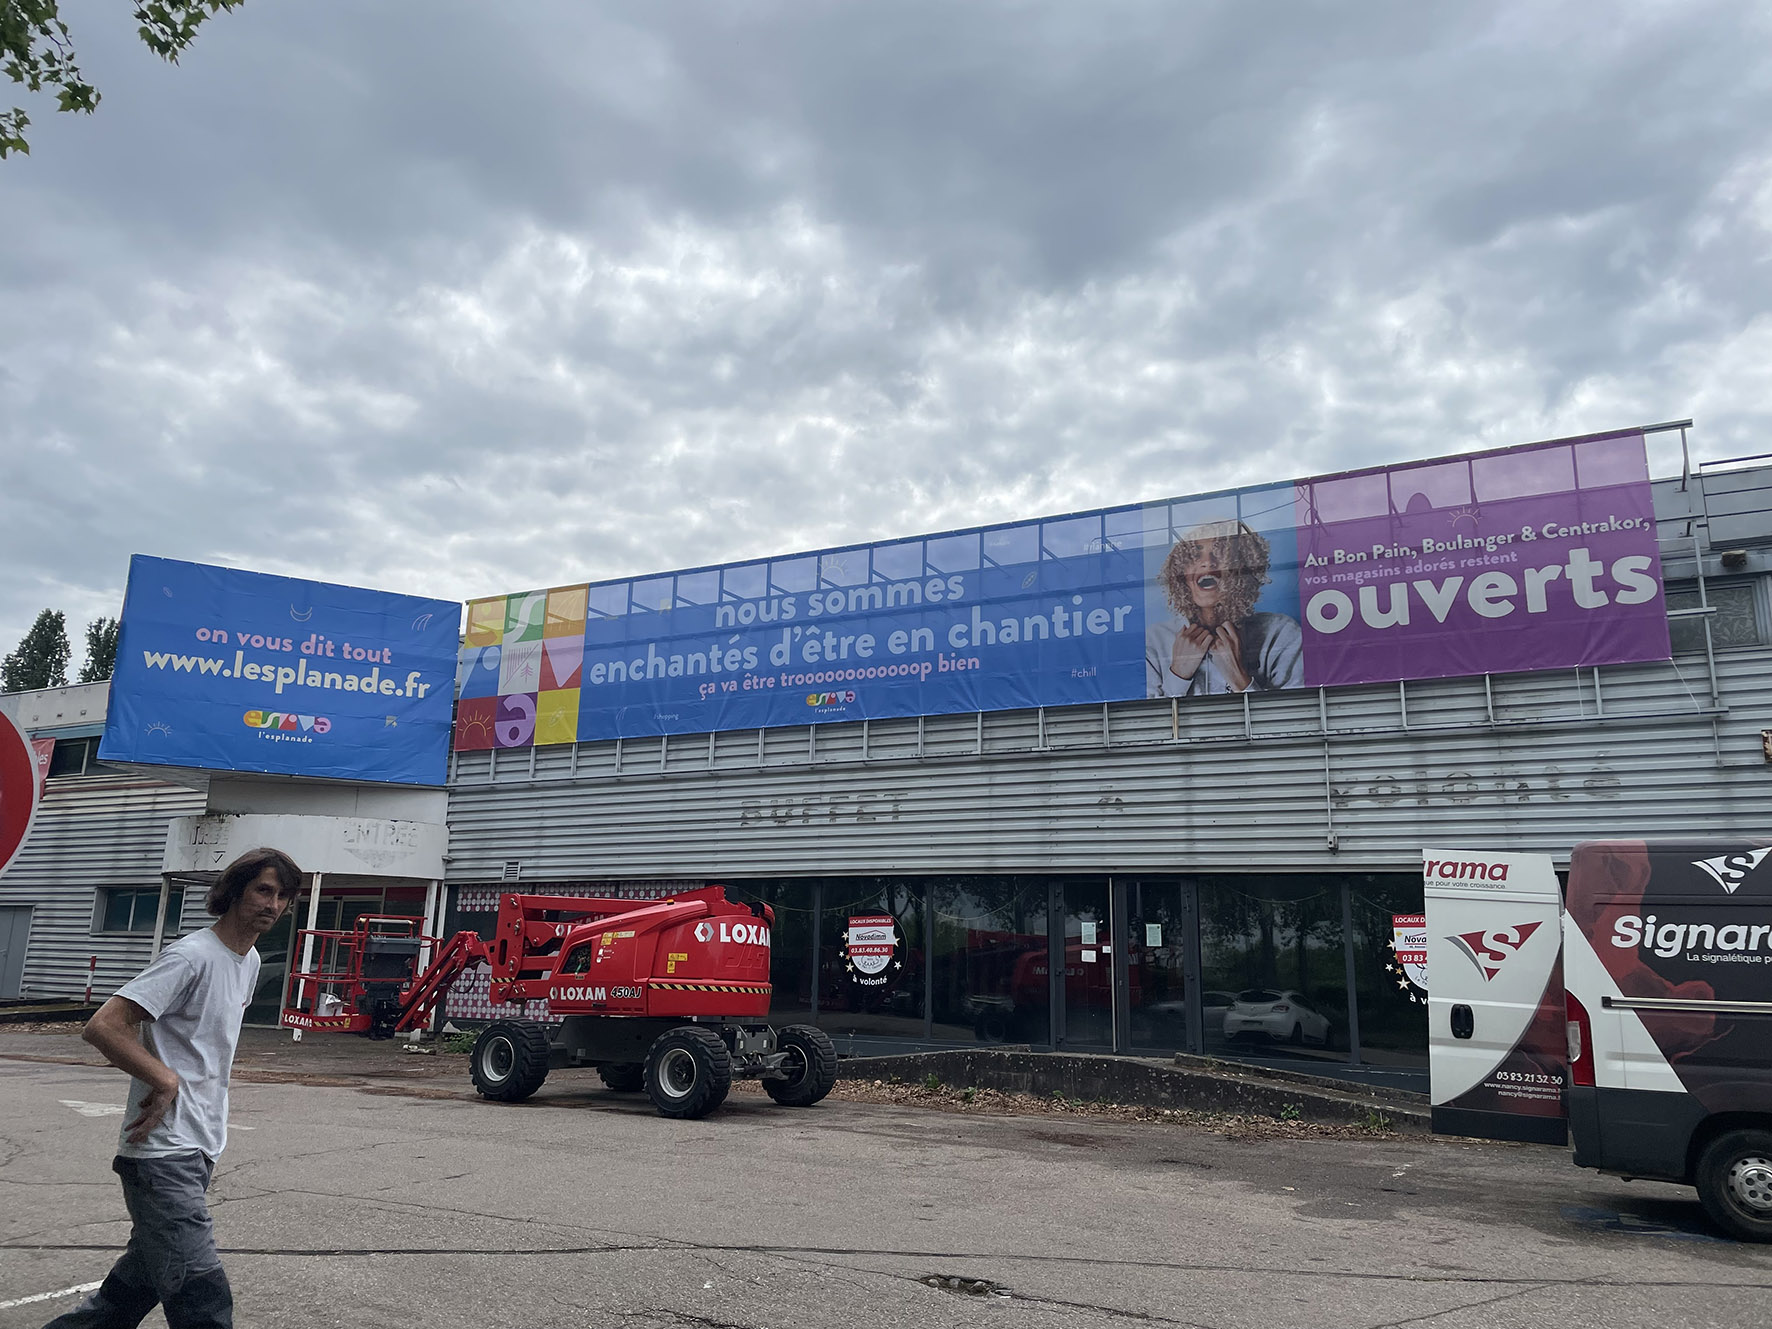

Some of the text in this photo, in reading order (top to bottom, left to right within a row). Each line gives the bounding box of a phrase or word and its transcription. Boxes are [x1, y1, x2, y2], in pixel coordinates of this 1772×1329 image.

[1304, 515, 1650, 568] Au Bon Pain, Boulanger & Centrakor,
[1304, 551, 1518, 585] vos magasins adorés restent
[715, 575, 964, 627] nous sommes
[1305, 548, 1658, 633] ouverts
[196, 627, 392, 664] on vous dit tout
[590, 634, 758, 684] enchantés
[887, 627, 934, 655] en
[948, 595, 1132, 648] chantier
[143, 651, 431, 698] www.lesplanade.fr
[699, 680, 716, 700] ça
[721, 679, 738, 692] va
[743, 673, 775, 691] être
[938, 652, 980, 672] bien
[1072, 666, 1096, 678] #chill
[259, 732, 313, 743] l'esplanade
[1423, 860, 1509, 881] rama
[1611, 915, 1772, 957] Signar
[1402, 954, 1423, 962] 03 83
[1686, 952, 1700, 961] La
[1702, 953, 1762, 963] signalétique
[560, 986, 642, 1000] LOXAM 450AJ
[860, 975, 887, 986] volonté
[284, 1014, 312, 1027] LOXAM
[1496, 1071, 1563, 1084] 03 83 21 32 30
